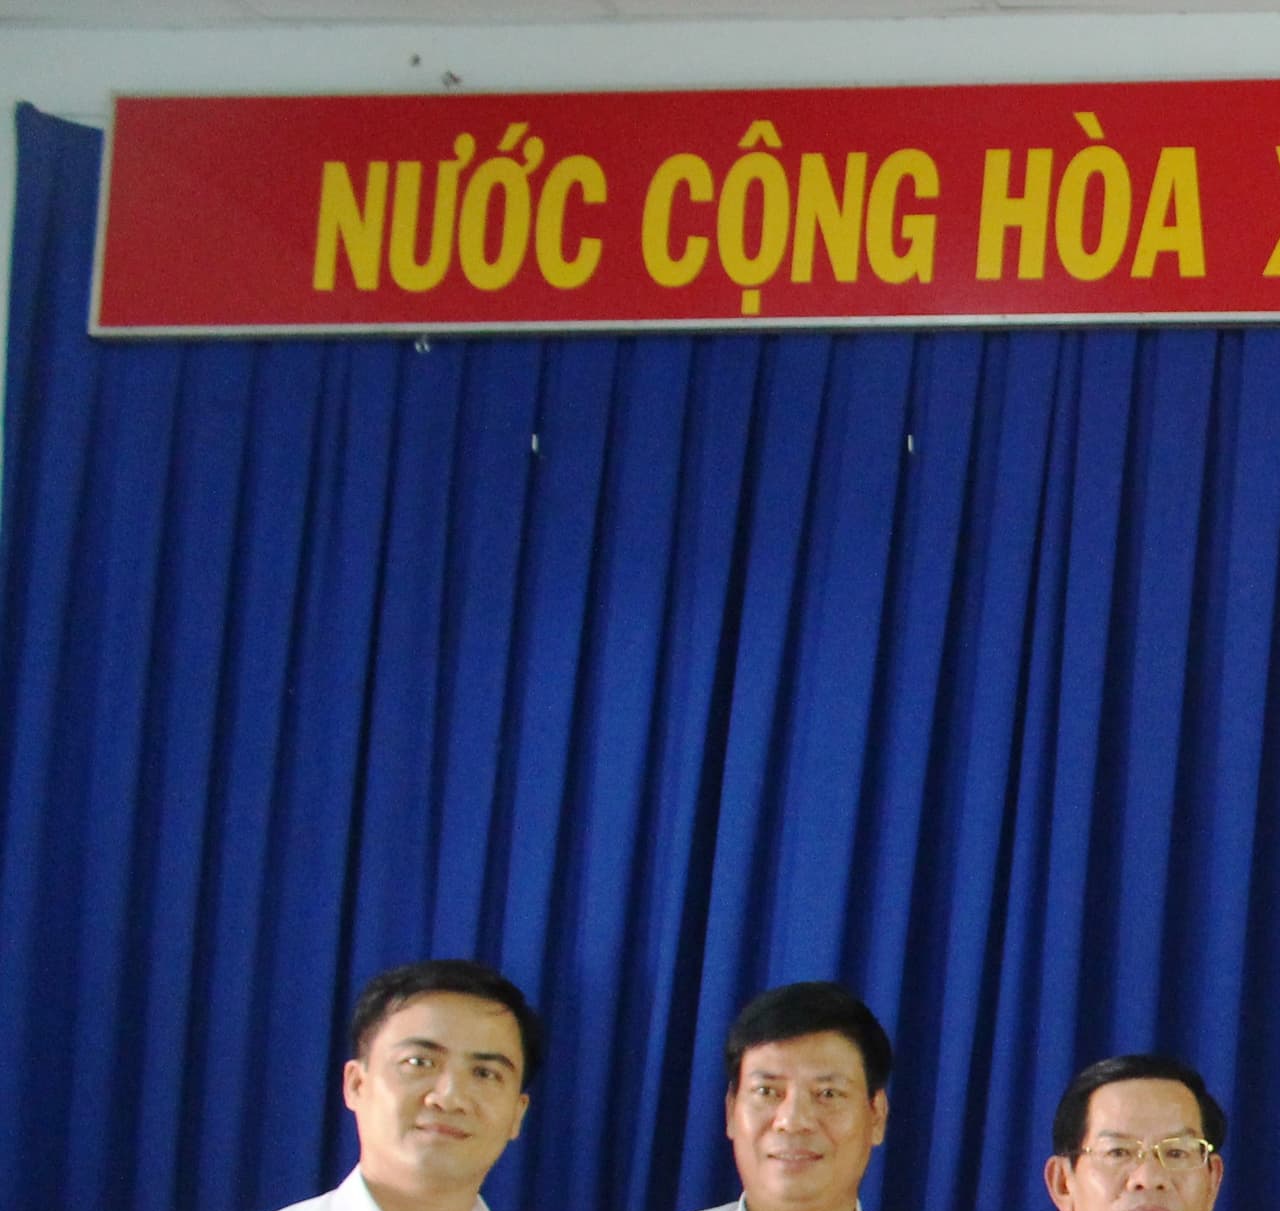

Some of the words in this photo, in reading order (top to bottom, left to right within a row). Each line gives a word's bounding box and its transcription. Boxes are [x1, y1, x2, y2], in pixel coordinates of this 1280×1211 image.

[315, 125, 607, 292] NƯỚC
[644, 123, 939, 315] CỘNG
[977, 114, 1206, 281] HÒA
